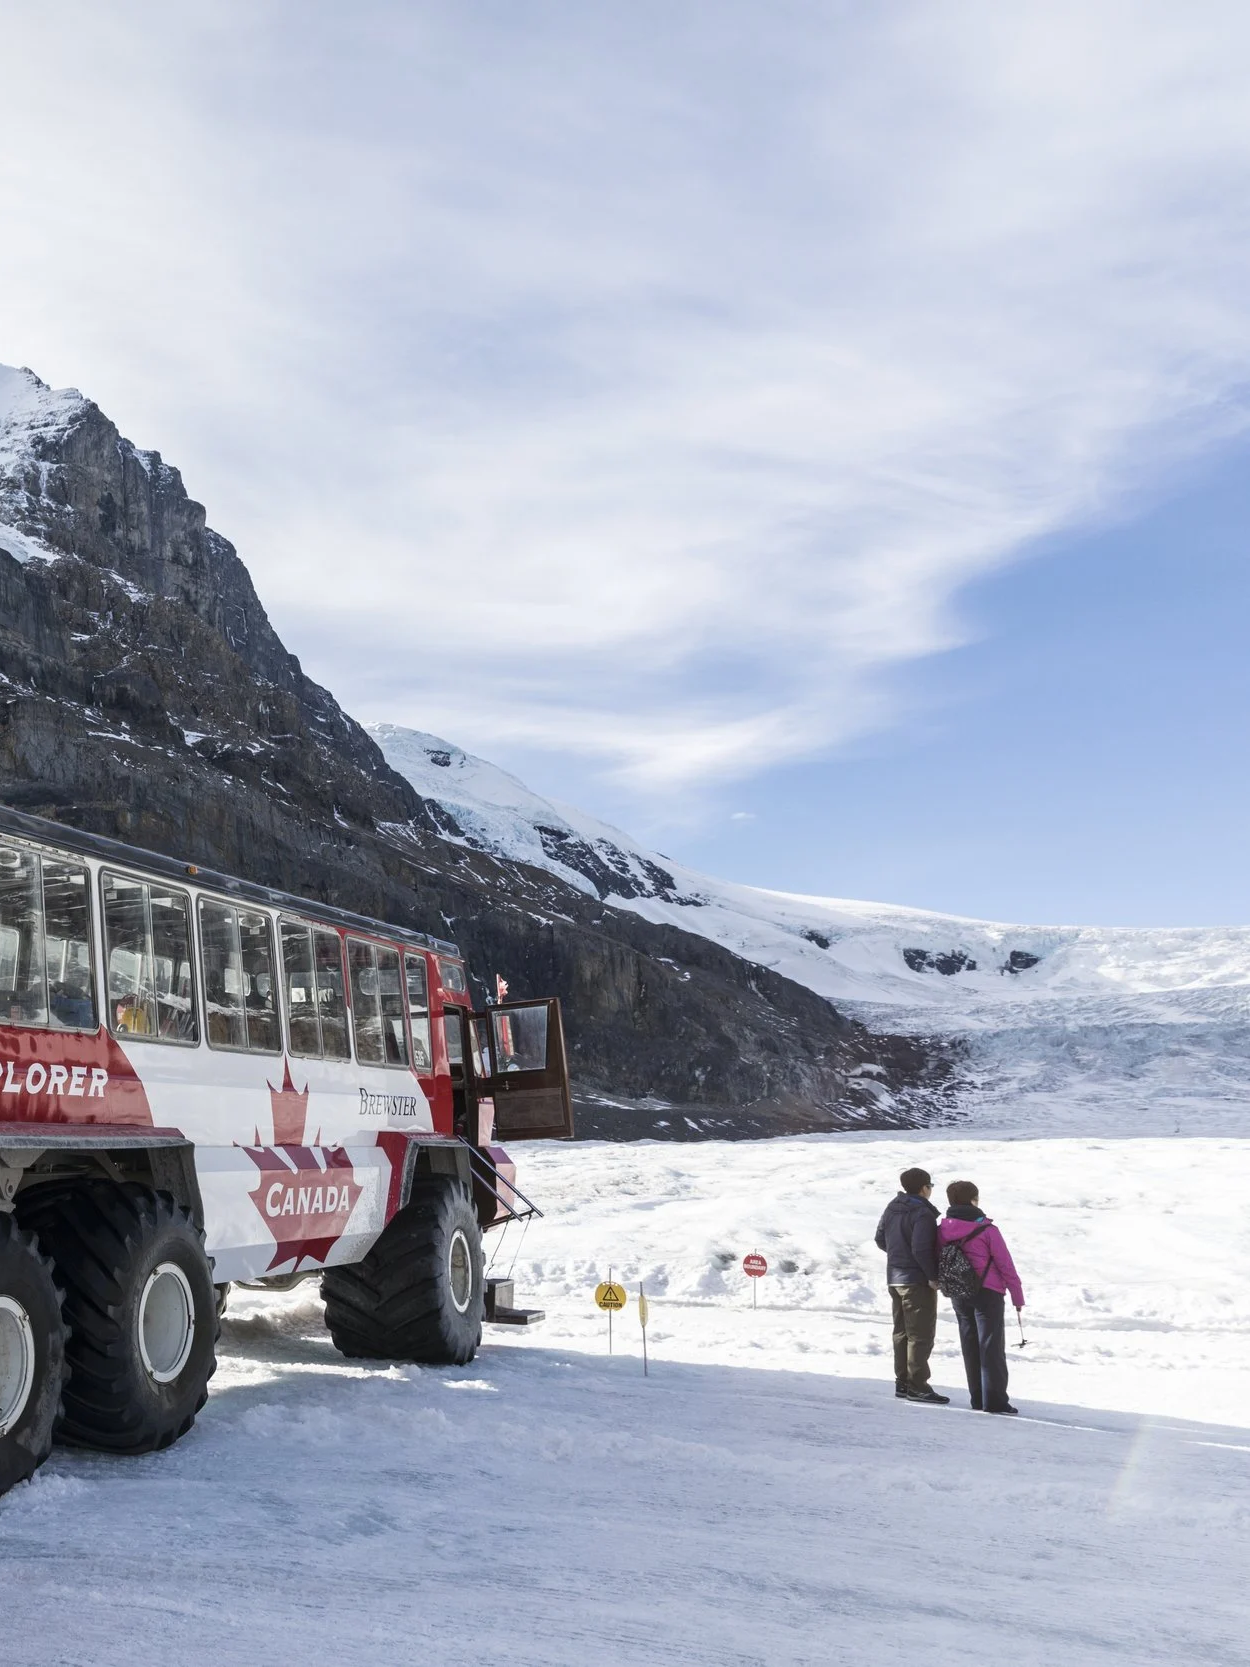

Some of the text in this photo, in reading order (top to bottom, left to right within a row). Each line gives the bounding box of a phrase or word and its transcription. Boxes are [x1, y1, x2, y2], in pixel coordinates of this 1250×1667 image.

[359, 1087, 417, 1116] BREWSTER
[265, 1182, 350, 1218] CANADA
[599, 1301, 623, 1309] CAUTION
